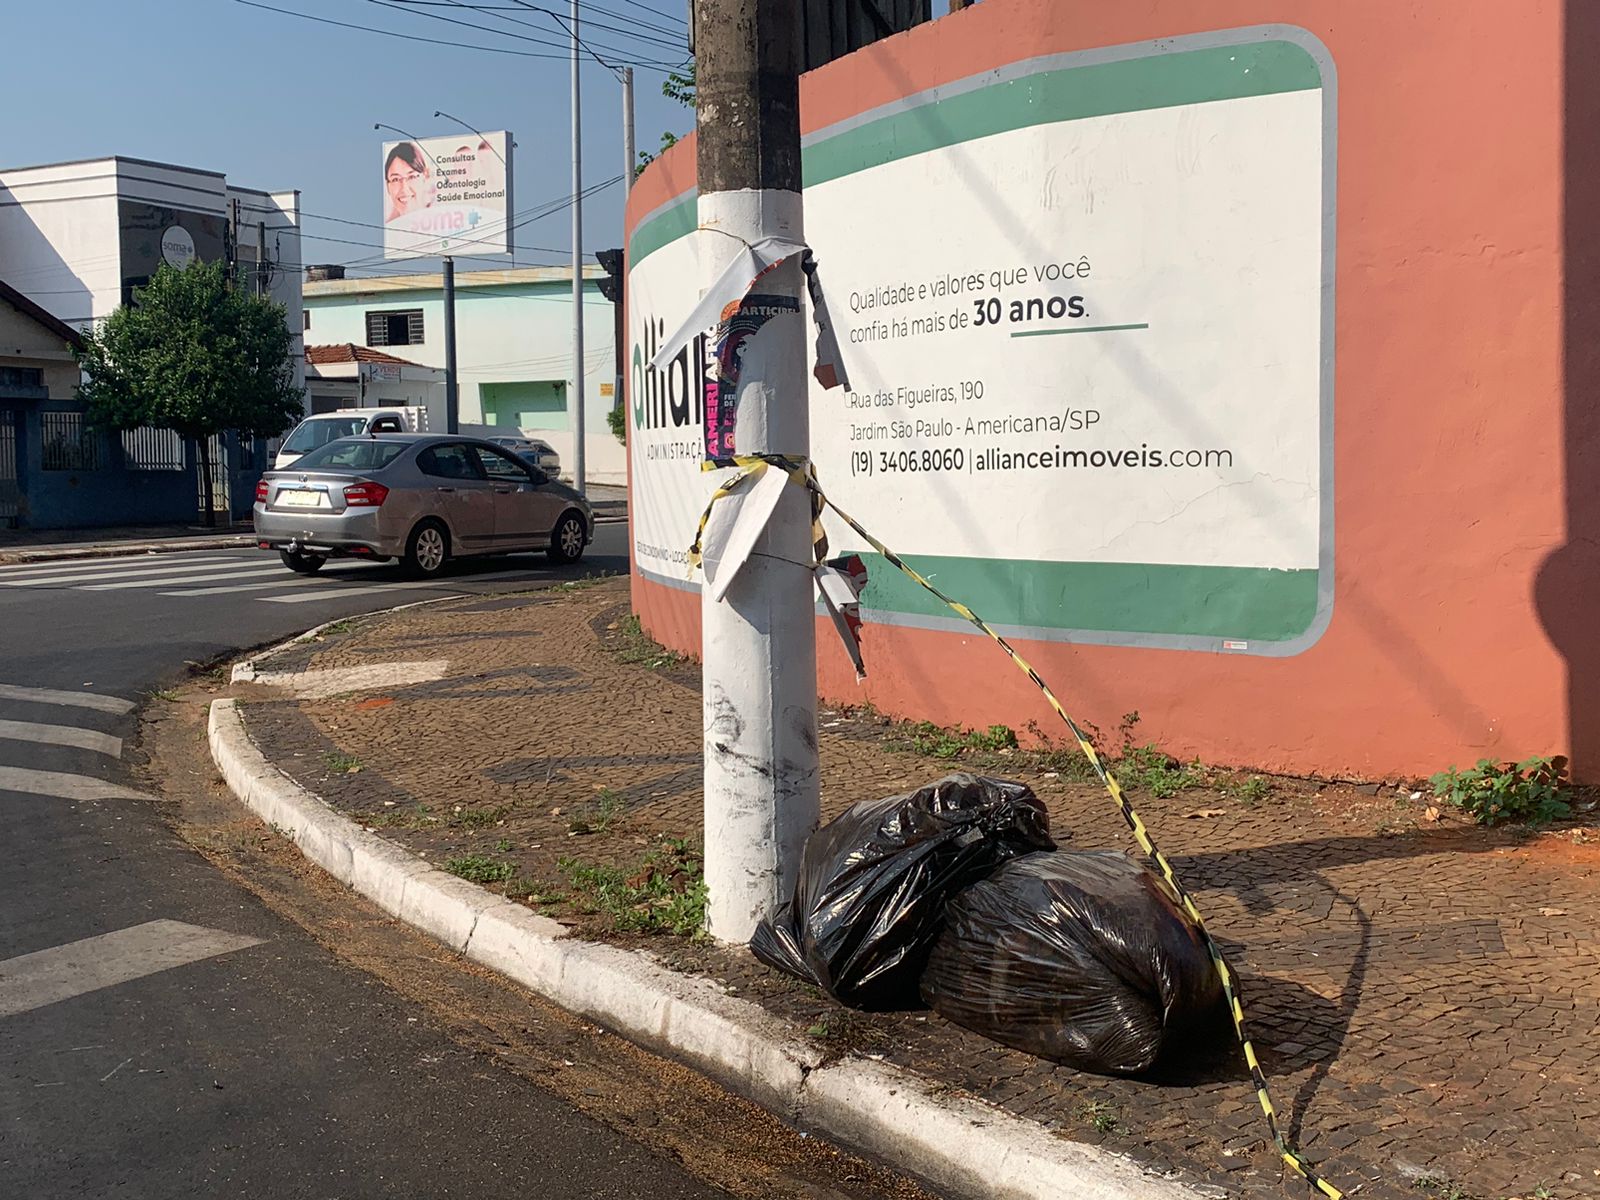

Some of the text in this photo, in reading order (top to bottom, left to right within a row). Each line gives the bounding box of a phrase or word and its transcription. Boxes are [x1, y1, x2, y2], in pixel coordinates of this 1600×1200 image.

[436, 154, 475, 164] Consultas
[436, 168, 467, 177] Exames
[436, 177, 486, 189] Odontologia
[436, 189, 505, 202] Saúde Emocional
[411, 211, 464, 231] soma
[850, 255, 1091, 314] Qualidade e valores que você
[850, 295, 1090, 343] confia há mais de 30 anos.
[632, 313, 701, 431] allia
[850, 380, 984, 409] Rua das Figueiras, 190
[850, 422, 888, 441] Jardim
[891, 420, 913, 439] São
[916, 417, 953, 438] Paulo
[964, 407, 1100, 435] Americana/SP
[647, 437, 702, 465] ADMINISTRAÇÃ
[851, 450, 873, 478] (19)
